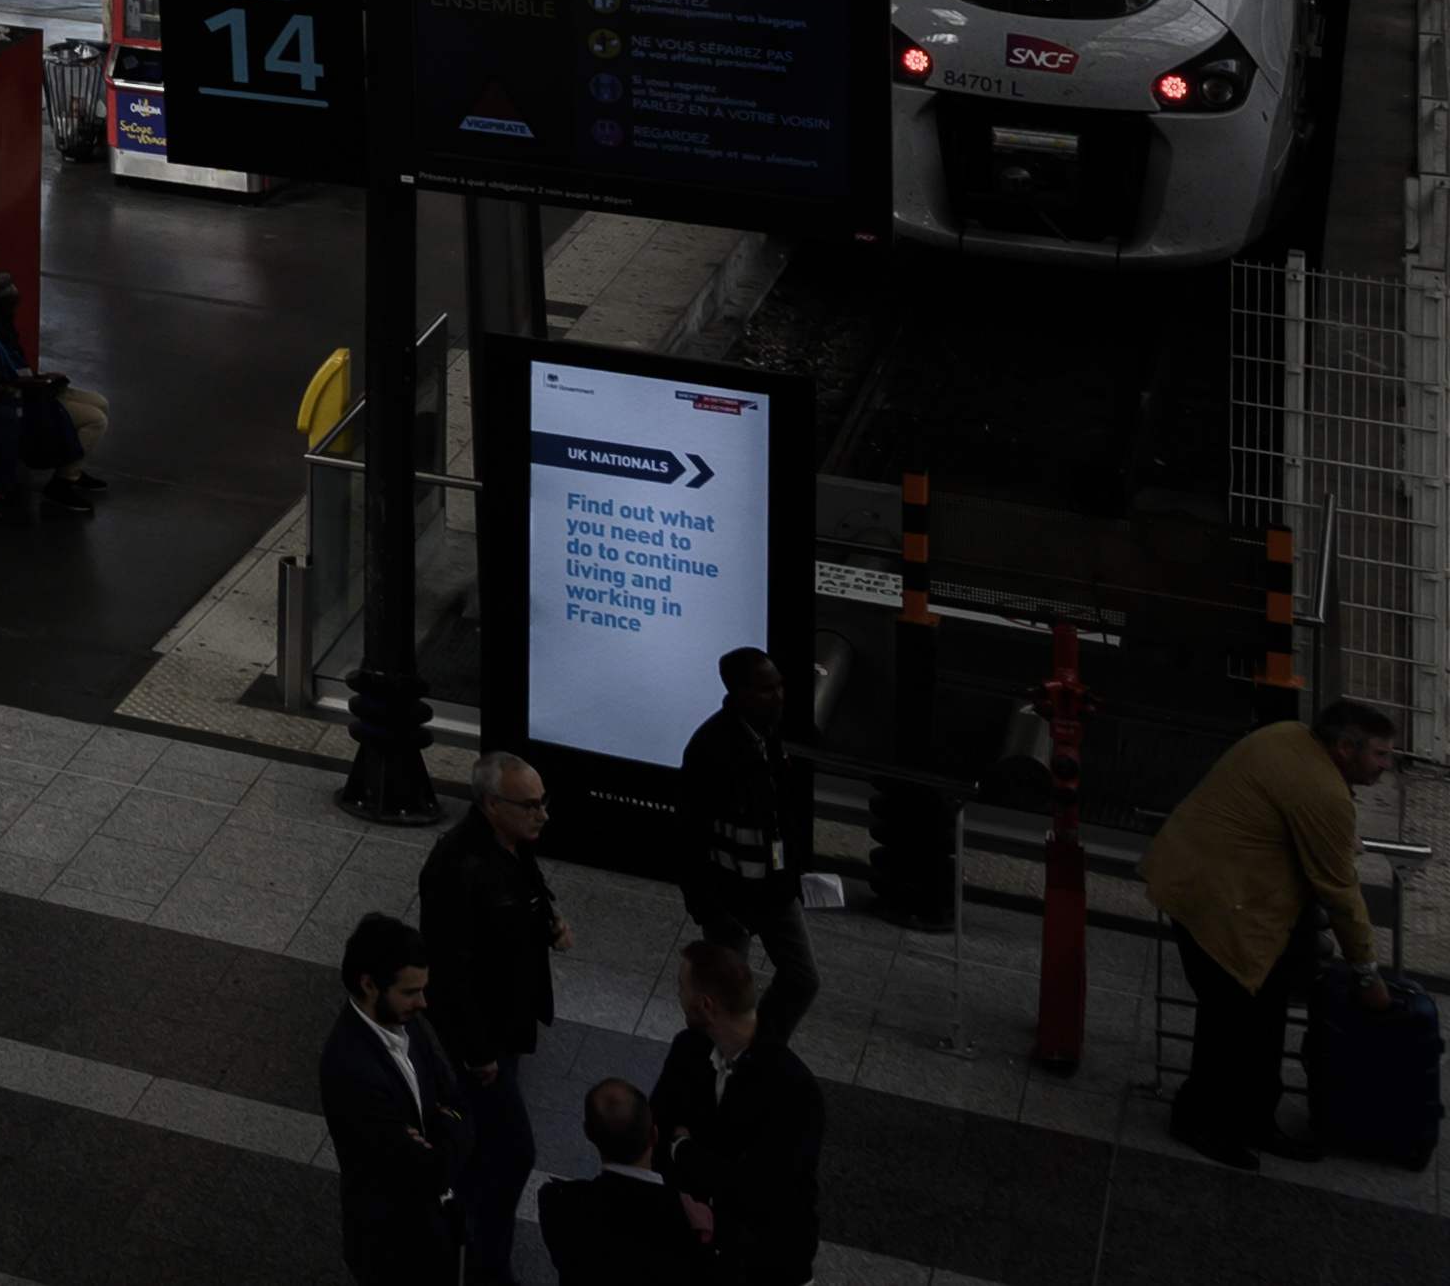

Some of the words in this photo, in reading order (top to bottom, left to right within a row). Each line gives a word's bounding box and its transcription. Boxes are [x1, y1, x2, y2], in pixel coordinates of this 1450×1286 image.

[203, 6, 325, 92] 14
[630, 34, 651, 48] NE
[655, 38, 695, 52] VOUS
[698, 40, 762, 58] SÉPAREZ
[766, 50, 794, 62] PAS
[1009, 47, 1074, 69] SNCF
[944, 70, 1003, 93] 84701
[1012, 81, 1024, 97] L
[465, 119, 527, 135] VIGIPIRATE
[633, 98, 685, 115] PARLEZ
[689, 105, 708, 117] EN
[729, 109, 775, 124] VOTRE
[780, 115, 830, 130] VOISIN
[633, 126, 709, 145] REGARDEZ
[567, 447, 587, 461] UK
[590, 451, 669, 474] NATIONALS
[568, 492, 613, 517] Find
[620, 505, 654, 522] out
[660, 510, 715, 532] what
[567, 518, 604, 537] you
[611, 525, 663, 547] need
[671, 533, 691, 550] to
[567, 538, 592, 557] do
[599, 543, 618, 561] to
[625, 550, 718, 577] continue
[567, 559, 625, 588] living
[632, 573, 671, 592] and
[566, 584, 655, 616] working
[662, 597, 682, 617] in
[567, 602, 641, 632] France
